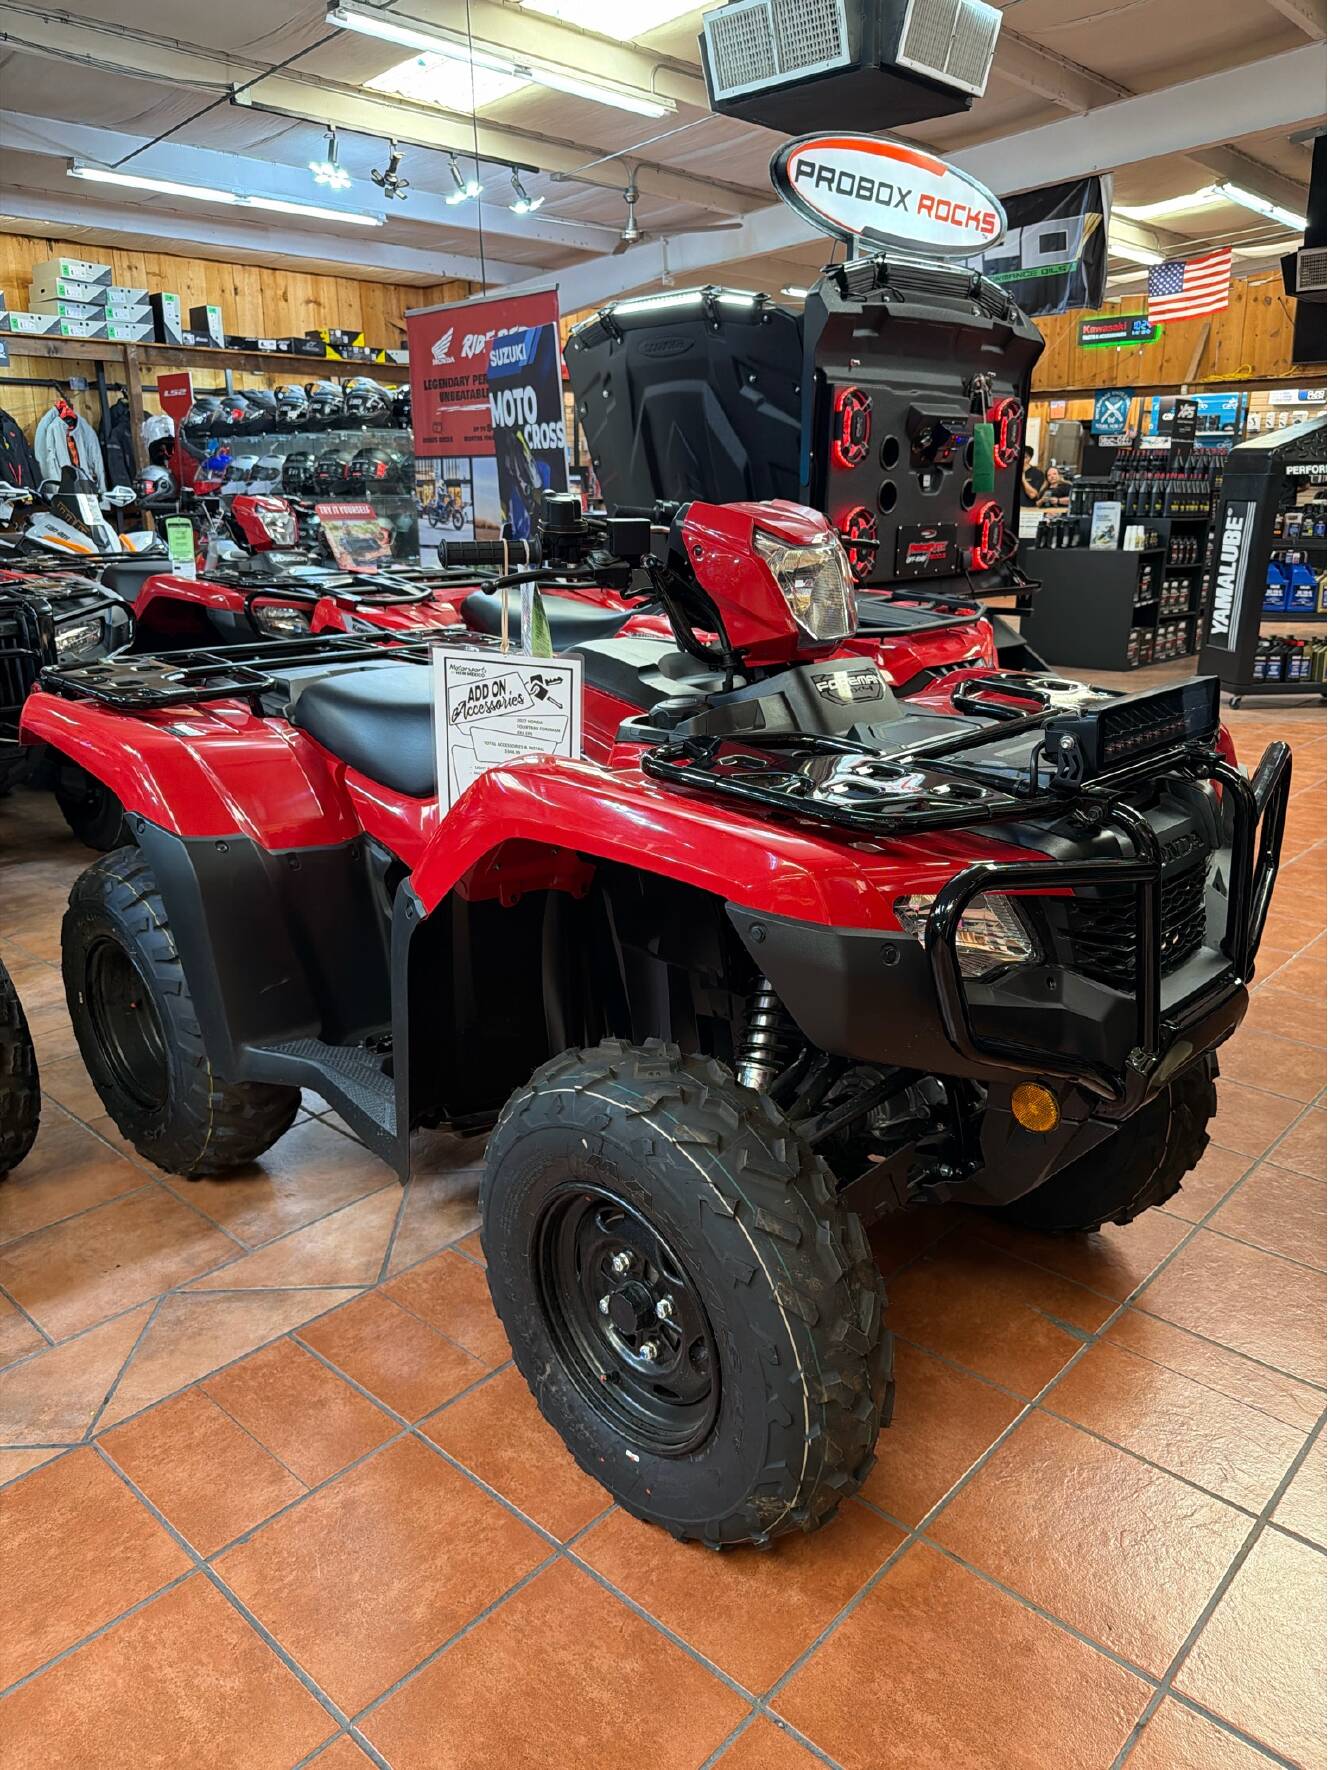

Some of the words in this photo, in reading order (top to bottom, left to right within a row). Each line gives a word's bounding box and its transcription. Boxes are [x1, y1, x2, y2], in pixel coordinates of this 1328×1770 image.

[794, 158, 912, 212] PROBOX
[917, 193, 996, 234] ROCKS
[1082, 322, 1127, 334] Kawasaki
[489, 344, 528, 367] SUZUKI
[423, 375, 470, 391] LEGENDARY
[489, 385, 538, 428] MOTO
[523, 420, 566, 450] CROSS
[319, 505, 333, 514] TRY
[339, 504, 371, 514] YOURSELF
[1210, 516, 1244, 635] YAMALUBE
[467, 683, 489, 704] ADD
[491, 678, 507, 698] ON
[815, 674, 881, 692] FOEMAN
[451, 690, 525, 723] Accessories
